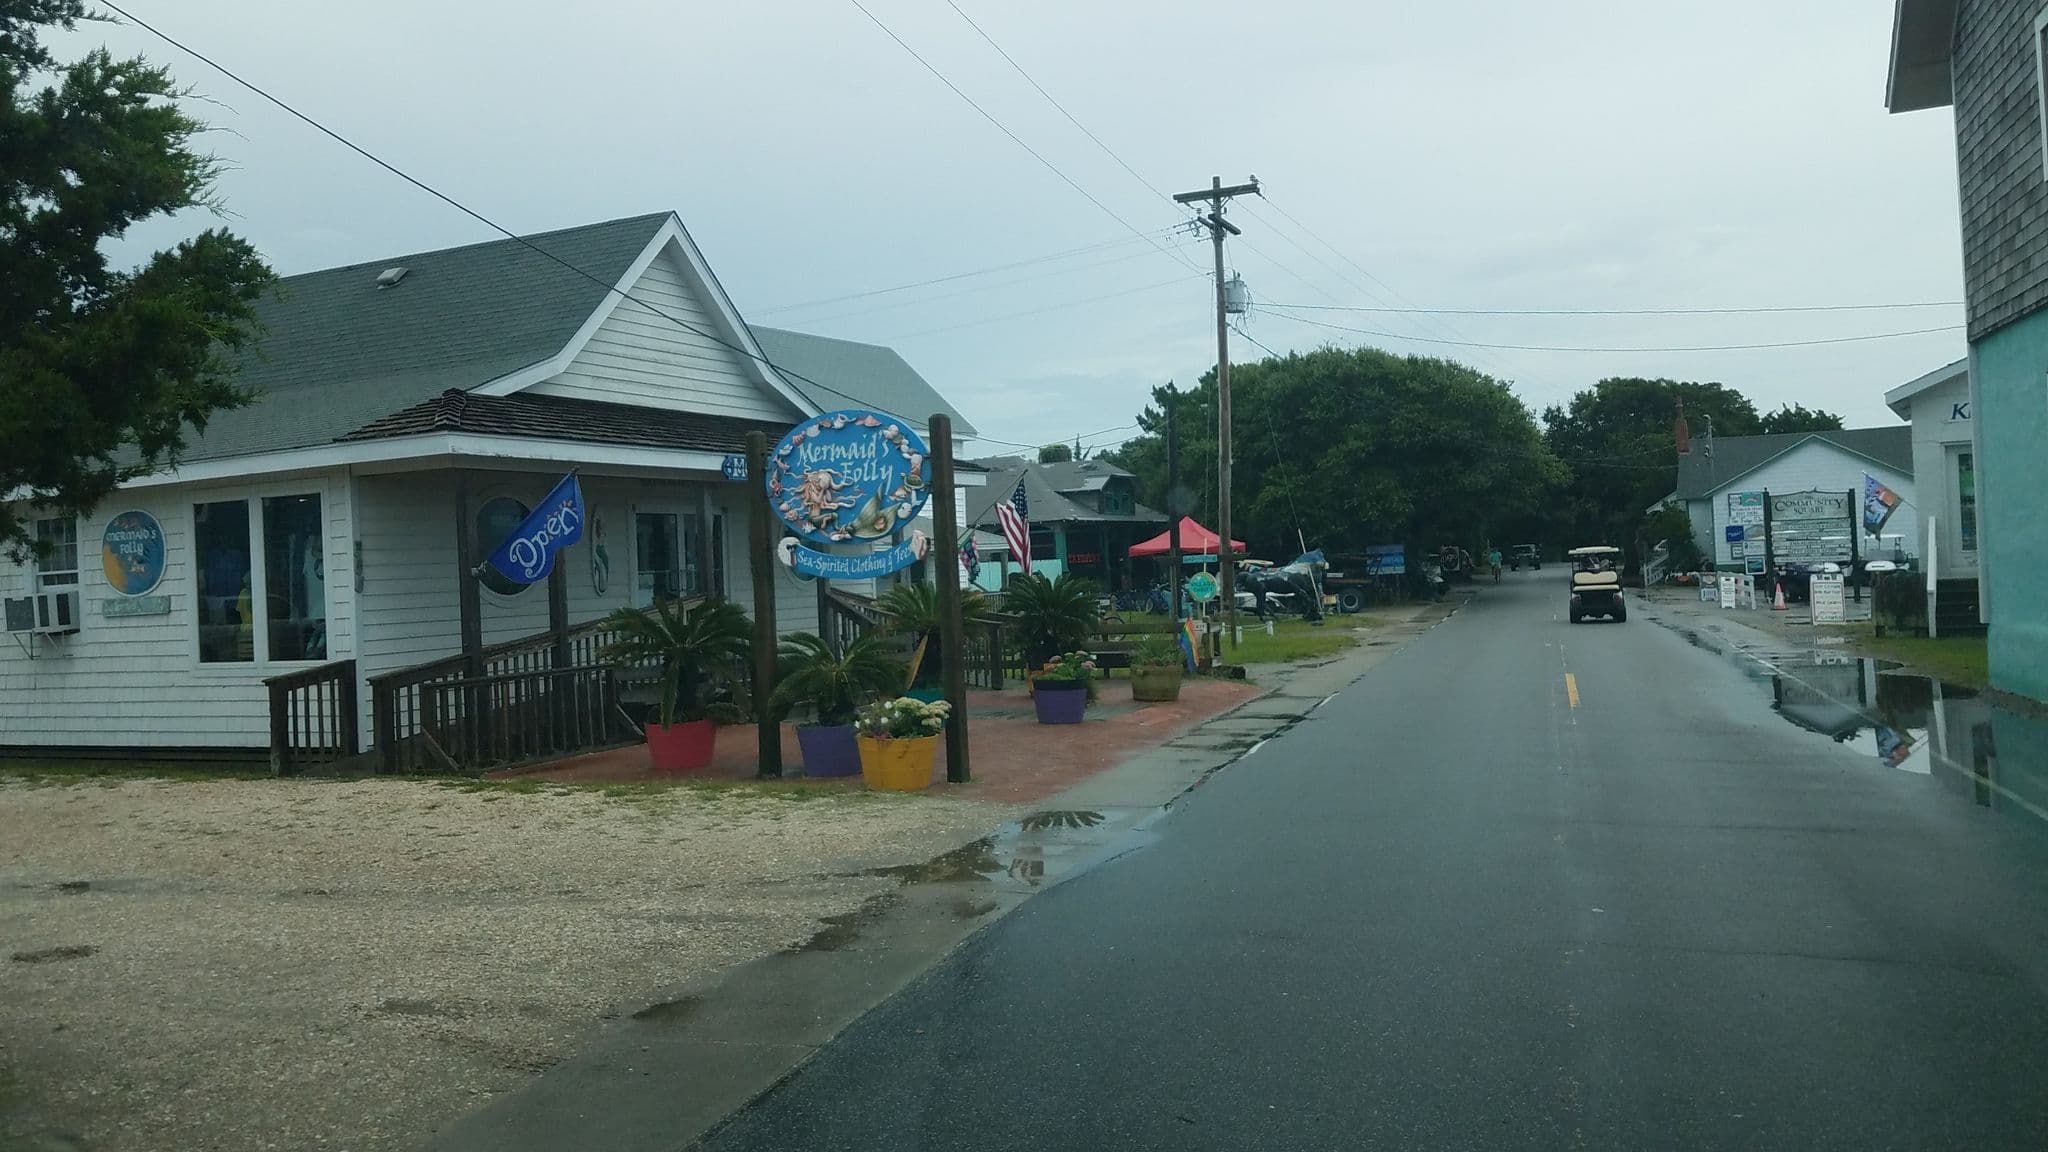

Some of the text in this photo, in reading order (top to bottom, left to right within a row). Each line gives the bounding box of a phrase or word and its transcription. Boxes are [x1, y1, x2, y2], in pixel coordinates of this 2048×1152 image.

[797, 431, 889, 465] Mermaid's
[840, 459, 893, 495] Folly
[1774, 498, 1844, 512] COMMUNITY
[1794, 506, 1824, 514] SQUARE
[509, 507, 579, 579] Open
[851, 555, 887, 574] Clothing
